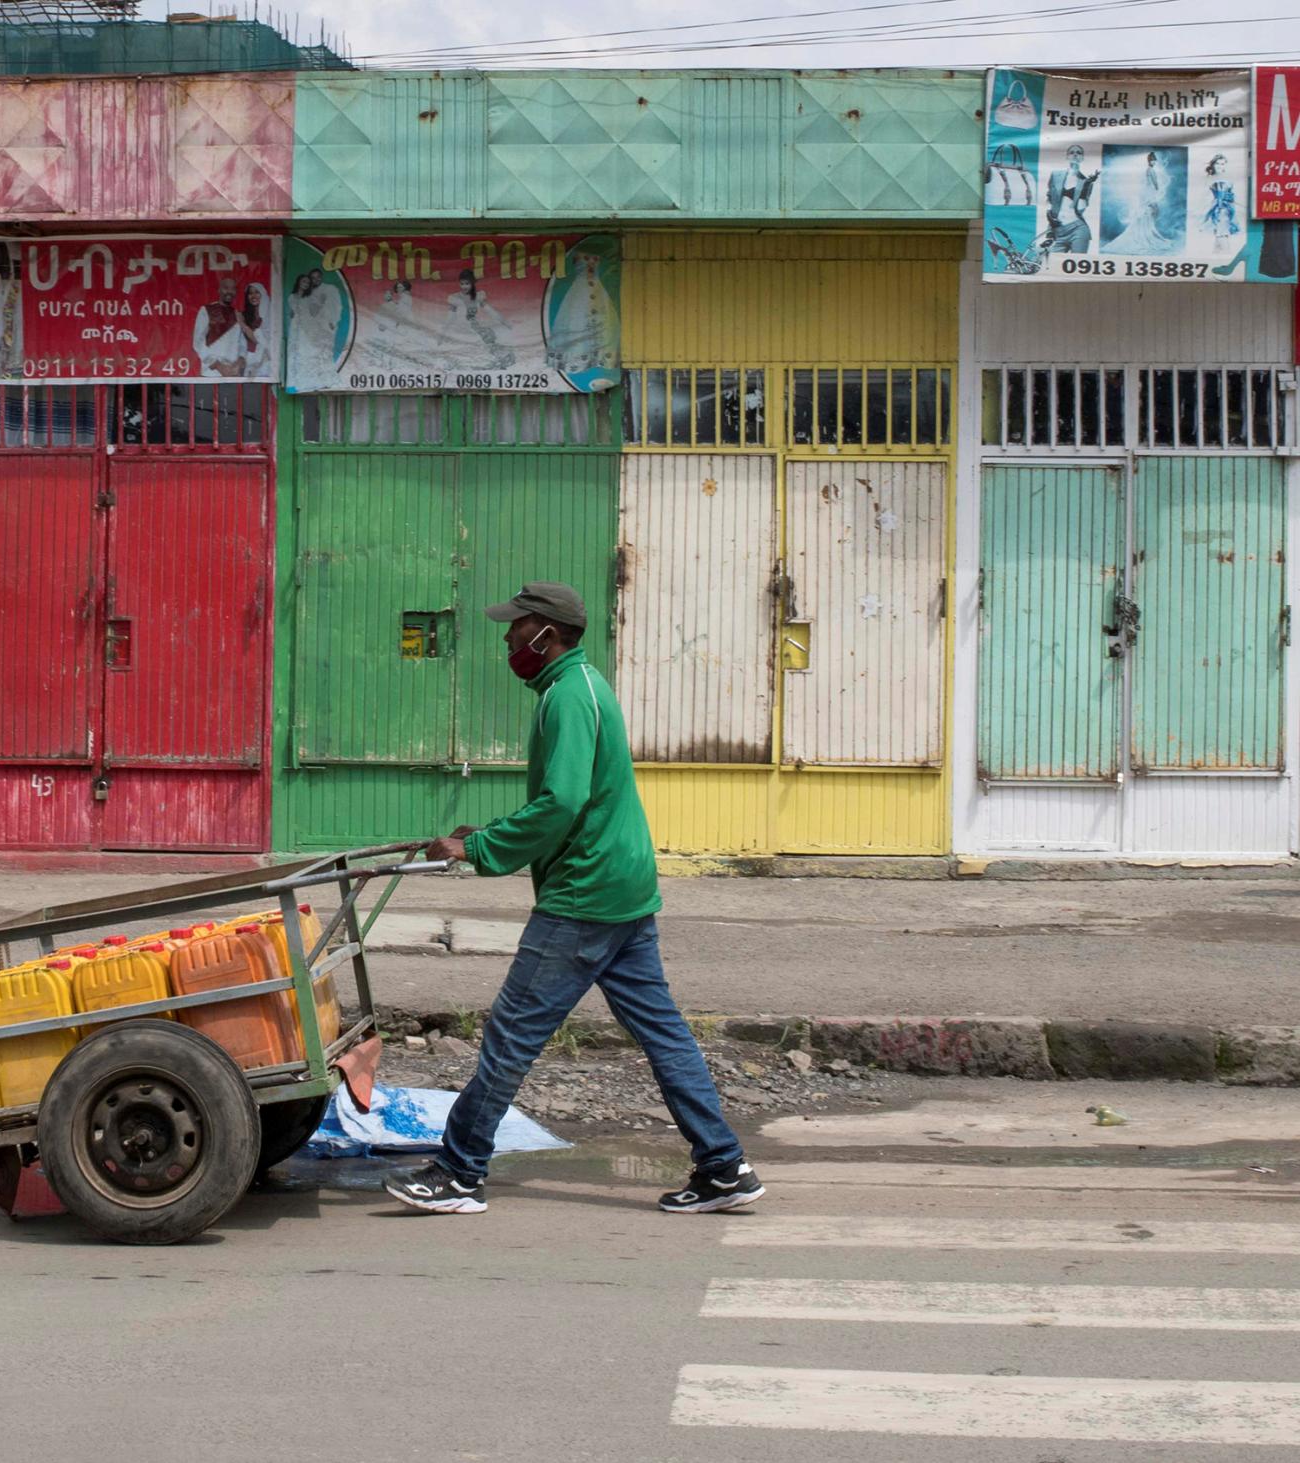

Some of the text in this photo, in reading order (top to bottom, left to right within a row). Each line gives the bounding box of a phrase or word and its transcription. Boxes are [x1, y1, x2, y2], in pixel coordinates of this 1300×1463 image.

[1047, 109, 1244, 131] Tsigereda collection
[28, 243, 249, 294] ሀብታሙ
[460, 240, 567, 279] ጥበብ
[1062, 259, 1209, 278] 0913 135887
[38, 301, 85, 318] የሀገር
[140, 299, 184, 316] ልብስ
[23, 357, 191, 377] 0911 15 32 49
[350, 374, 385, 388] 0910
[457, 374, 492, 388] 0969
[496, 374, 549, 388] 137228
[32, 774, 55, 796] 43
